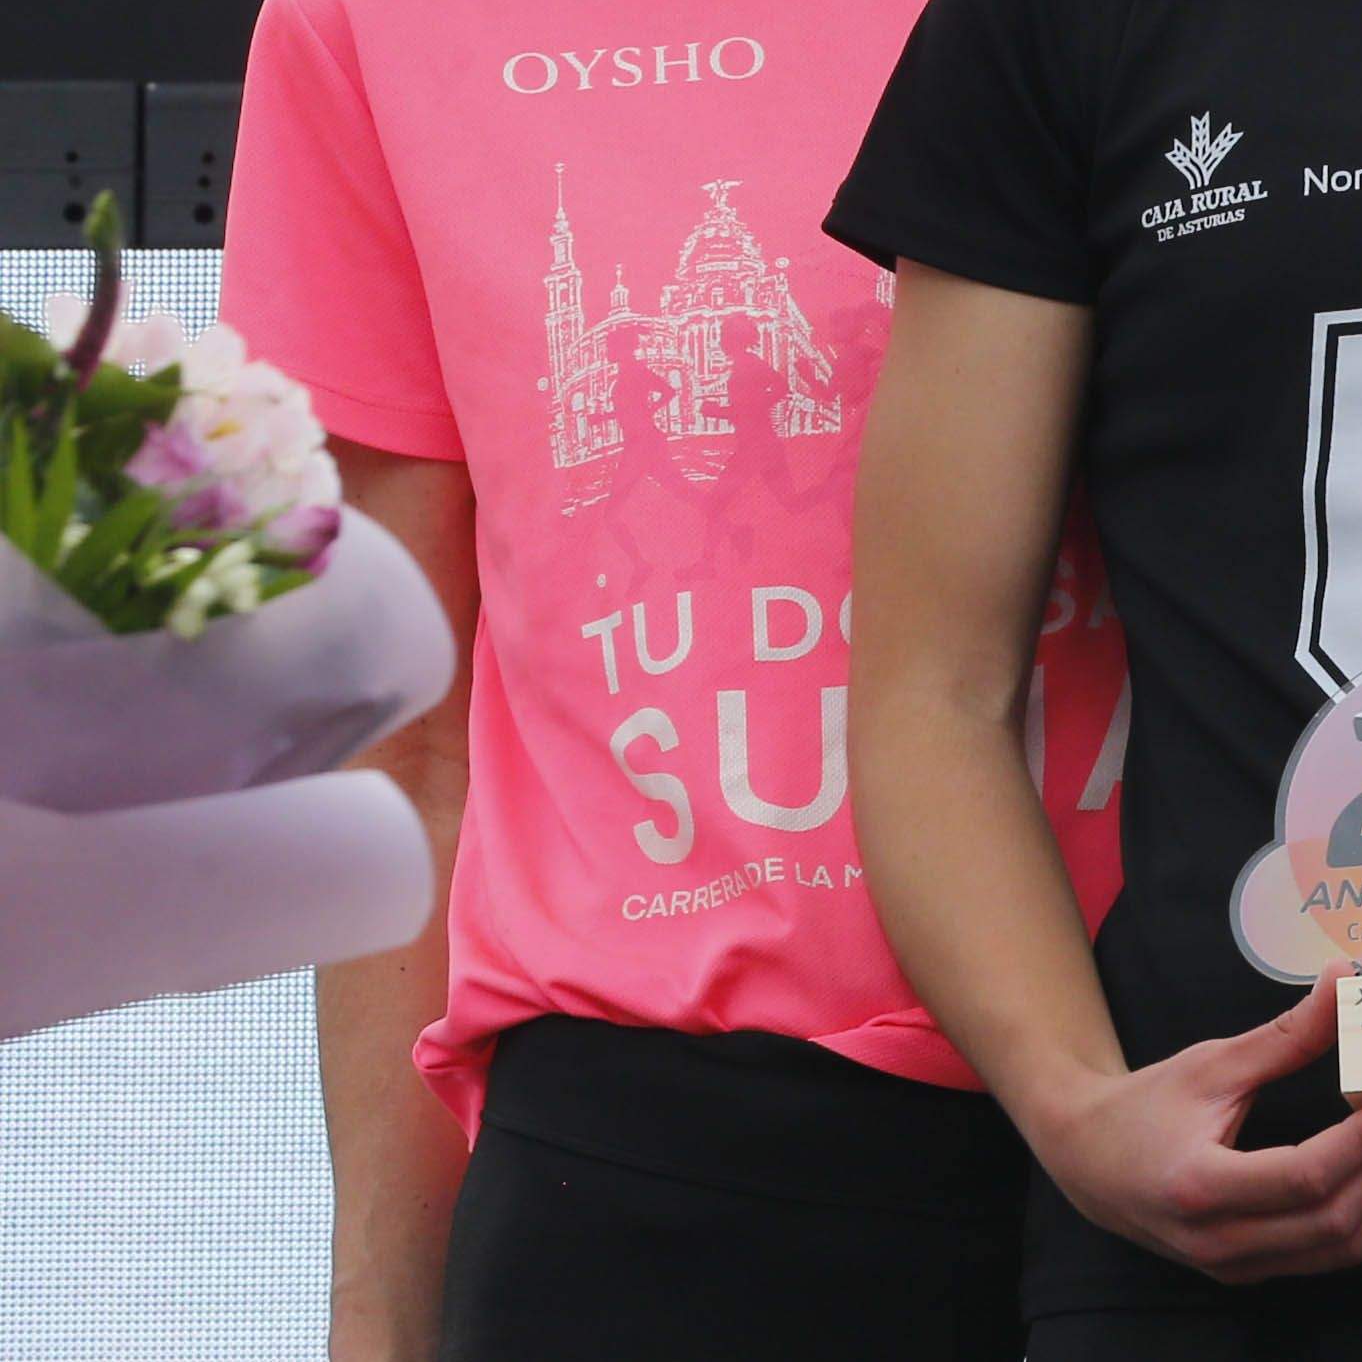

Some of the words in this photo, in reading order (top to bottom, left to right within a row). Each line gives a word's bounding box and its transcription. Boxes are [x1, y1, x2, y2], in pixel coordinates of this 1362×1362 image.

[502, 37, 765, 94] OYSHO
[1141, 203, 1186, 229] CAJA
[1189, 180, 1269, 216] RURAL
[1157, 227, 1174, 242] DE
[1177, 208, 1246, 236] ASTURIAS
[581, 591, 693, 694] TU
[622, 872, 747, 921] CARRERA
[743, 857, 785, 888] DE
[795, 862, 834, 889] LA
